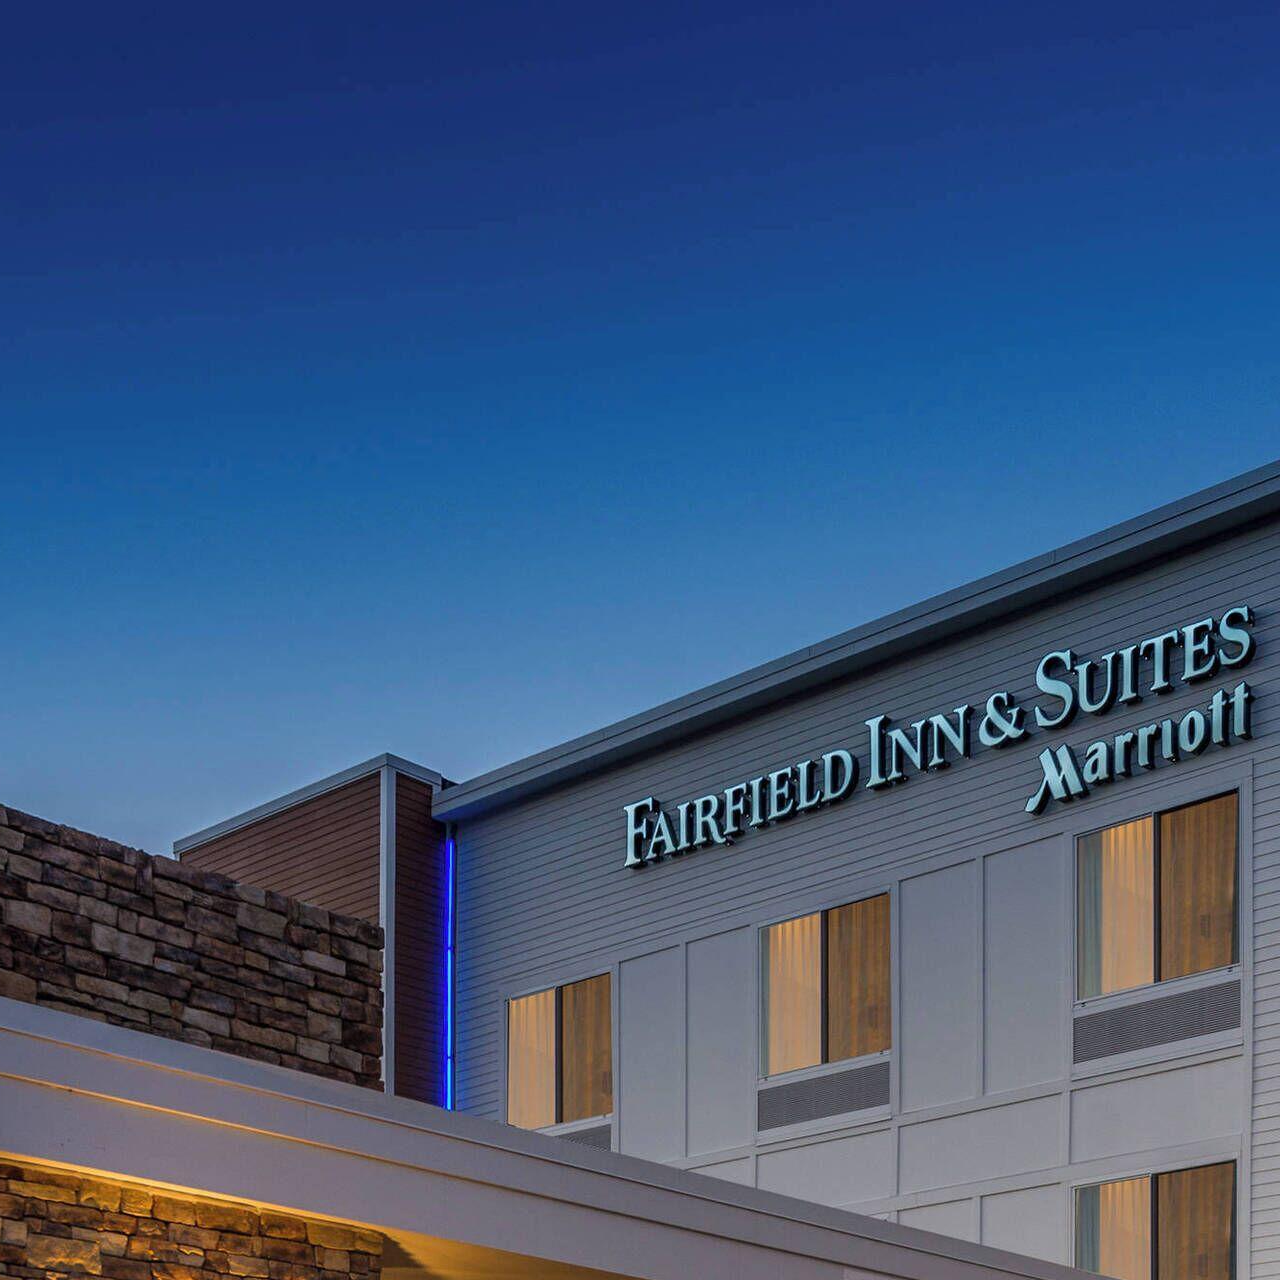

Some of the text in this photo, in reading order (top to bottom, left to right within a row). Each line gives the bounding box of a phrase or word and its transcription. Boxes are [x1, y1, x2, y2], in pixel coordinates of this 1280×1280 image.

[622, 604, 1256, 870] FAIRFIELD INN & SUITES
[1024, 681, 1255, 816] Marriott
